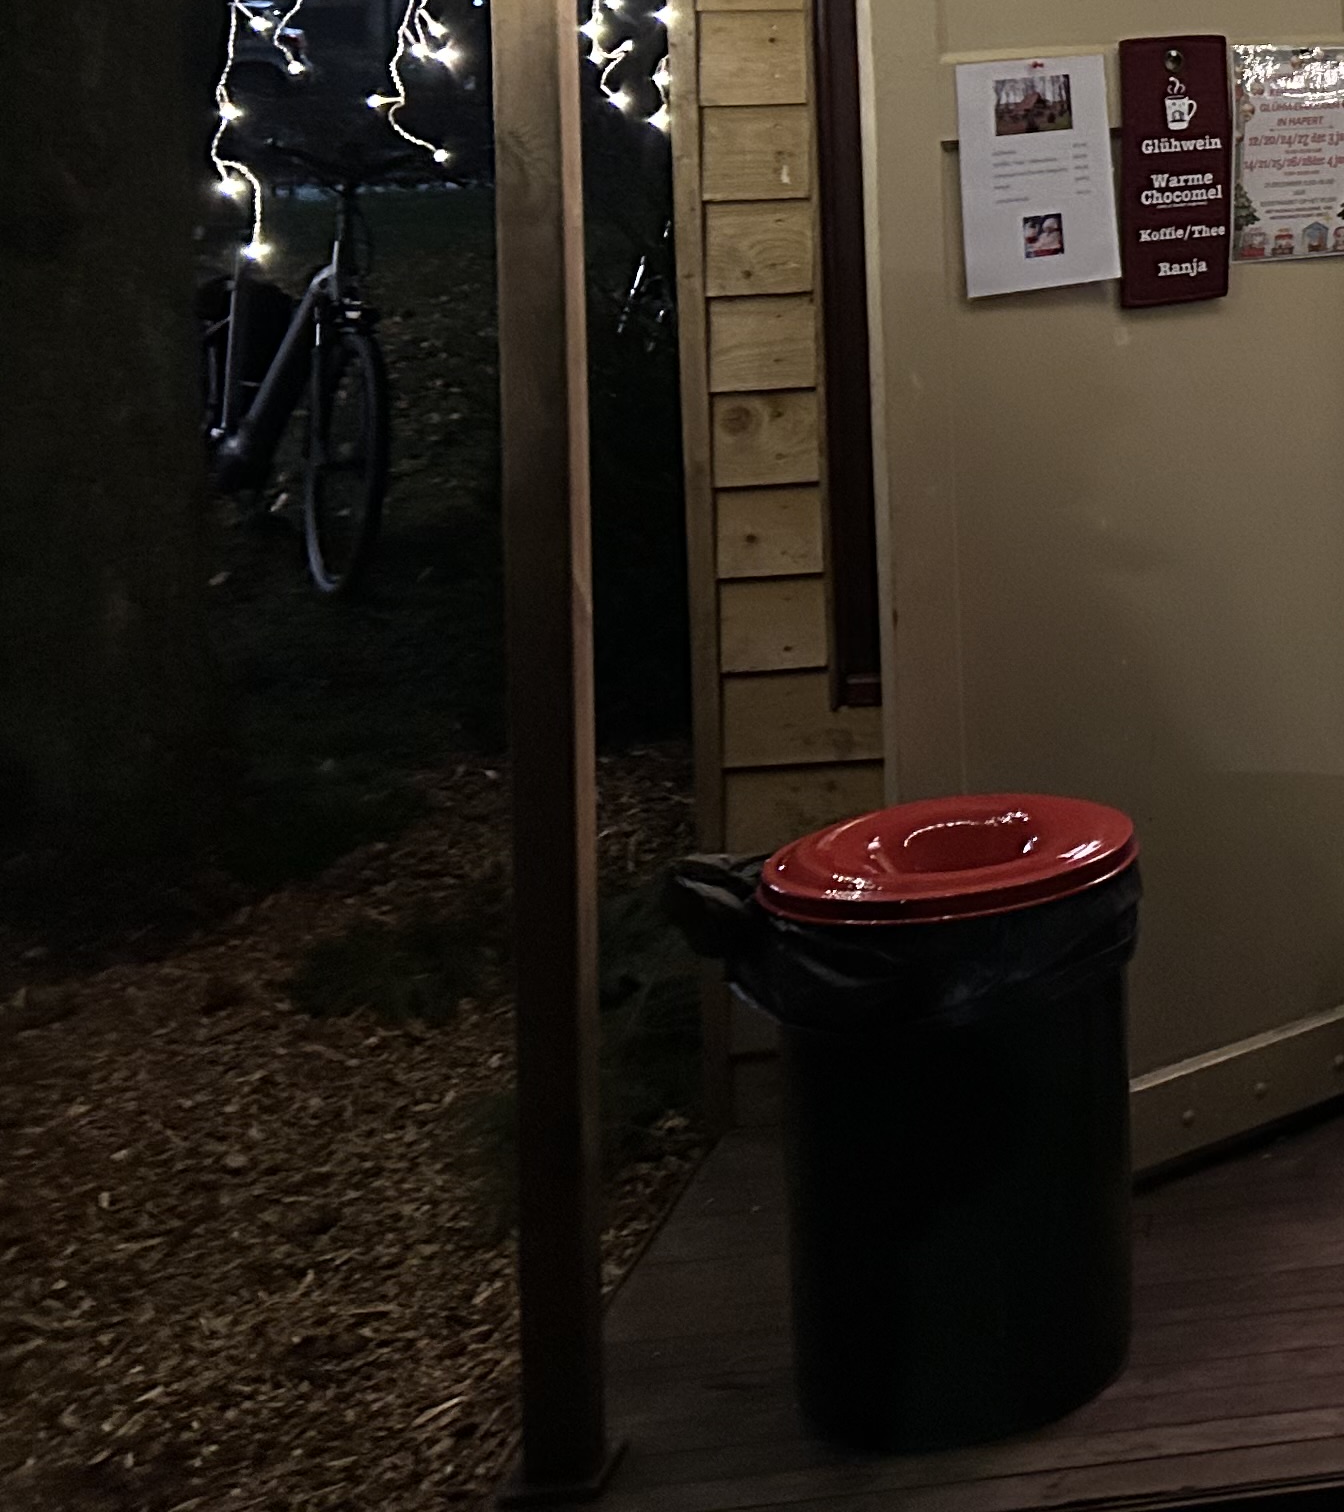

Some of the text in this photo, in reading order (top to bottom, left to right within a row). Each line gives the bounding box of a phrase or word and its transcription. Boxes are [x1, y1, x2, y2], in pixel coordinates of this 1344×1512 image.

[1141, 135, 1223, 154] Glühwein
[1150, 172, 1214, 188] Warme
[1140, 184, 1223, 205] Chocomel
[1138, 224, 1226, 242] Koffie/Thee
[1157, 258, 1208, 277] Ranja
